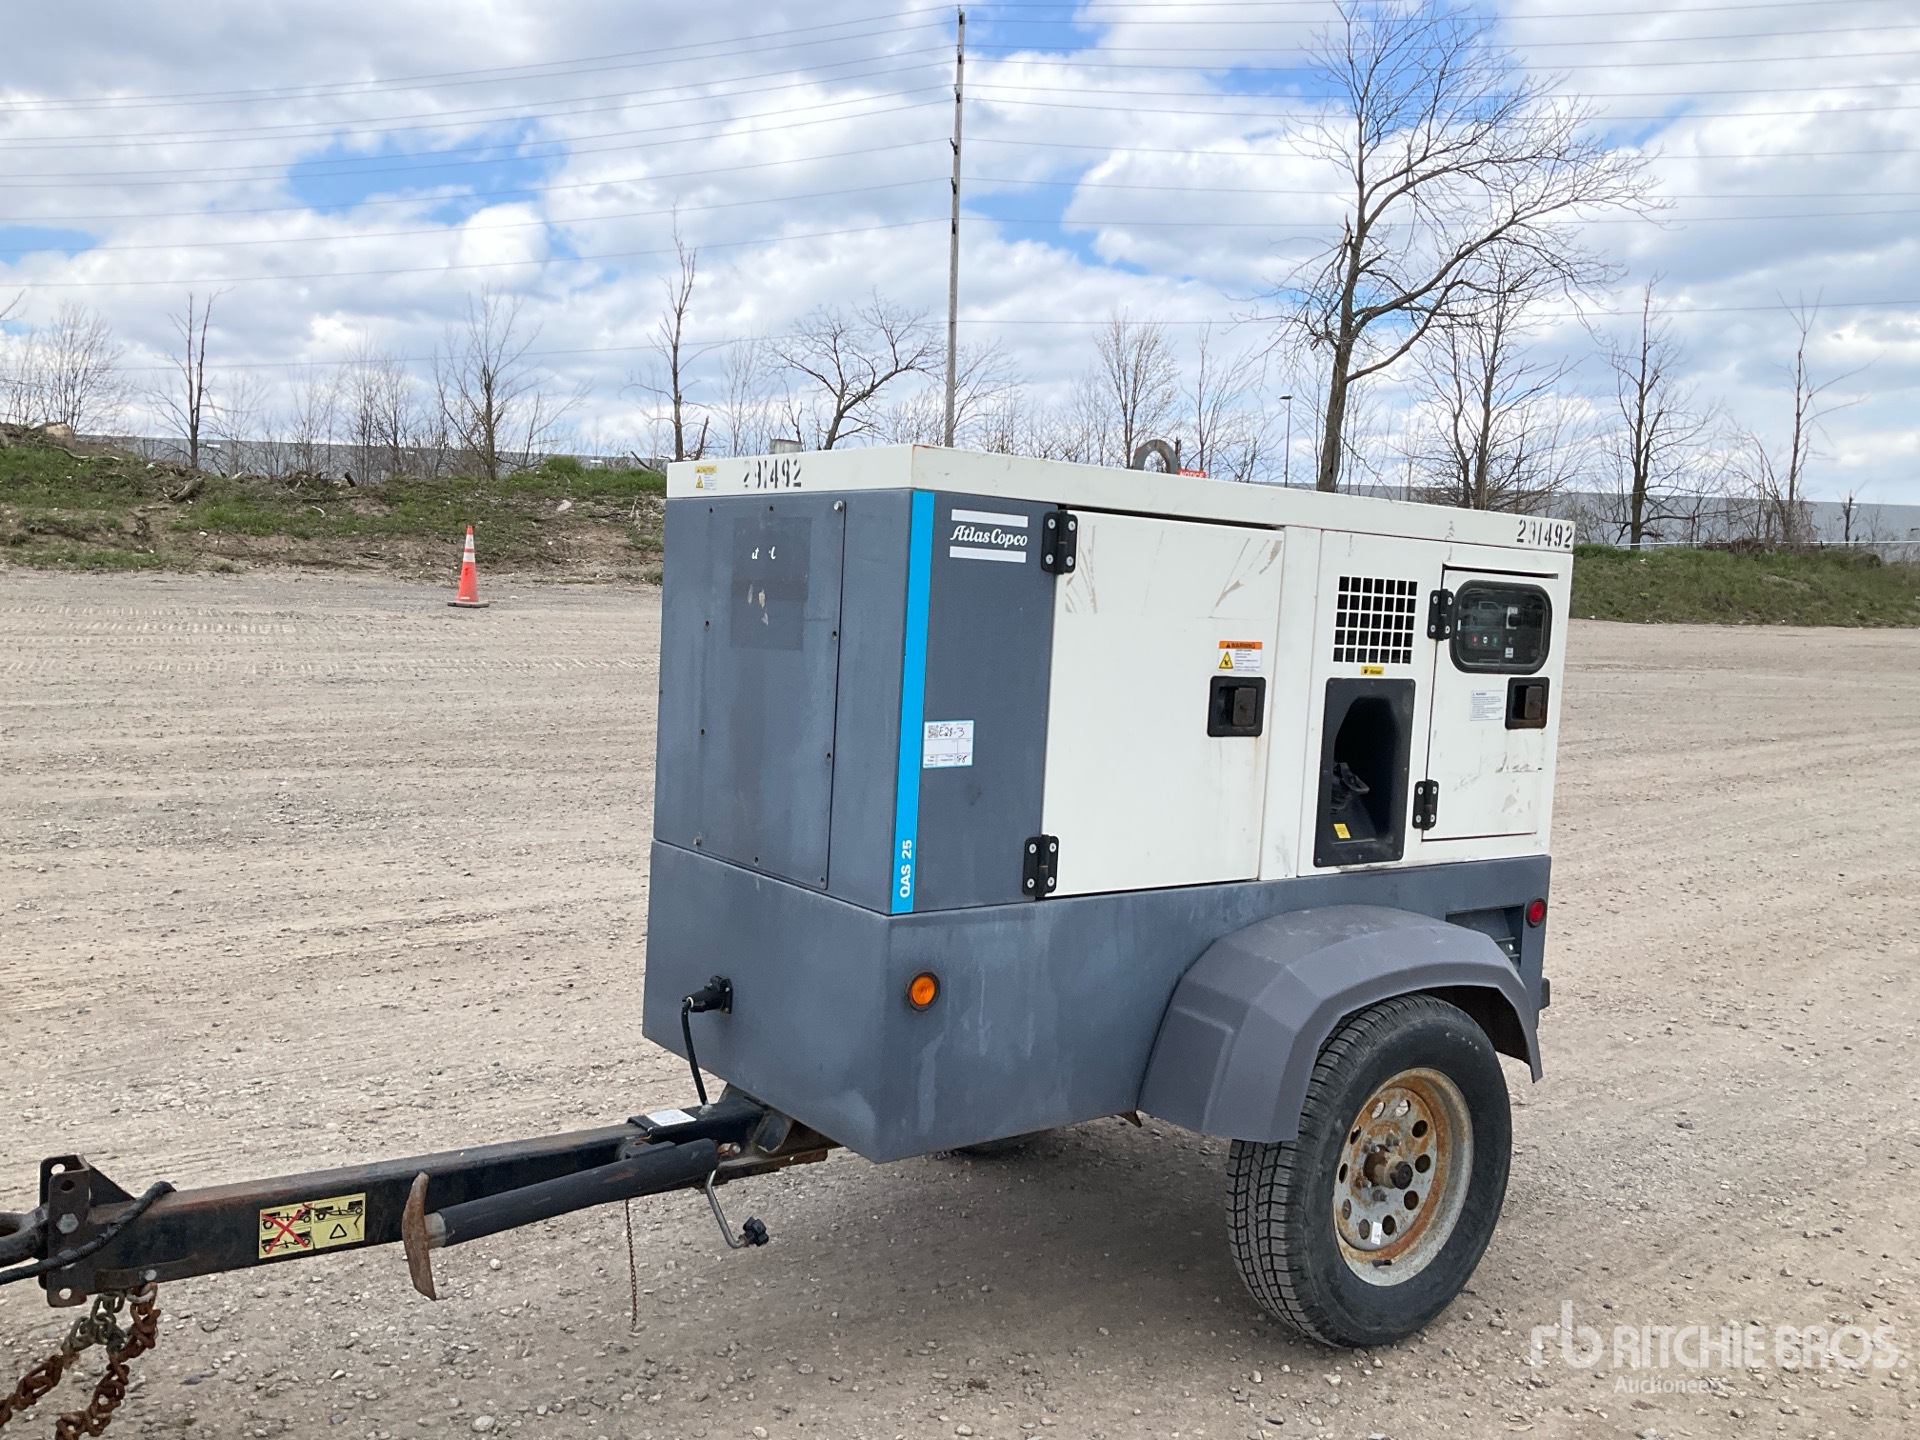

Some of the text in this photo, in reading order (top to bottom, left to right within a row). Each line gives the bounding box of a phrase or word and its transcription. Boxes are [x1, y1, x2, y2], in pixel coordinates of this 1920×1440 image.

[1231, 641, 1256, 649] WARNING
[899, 839, 913, 898] QAS 25
